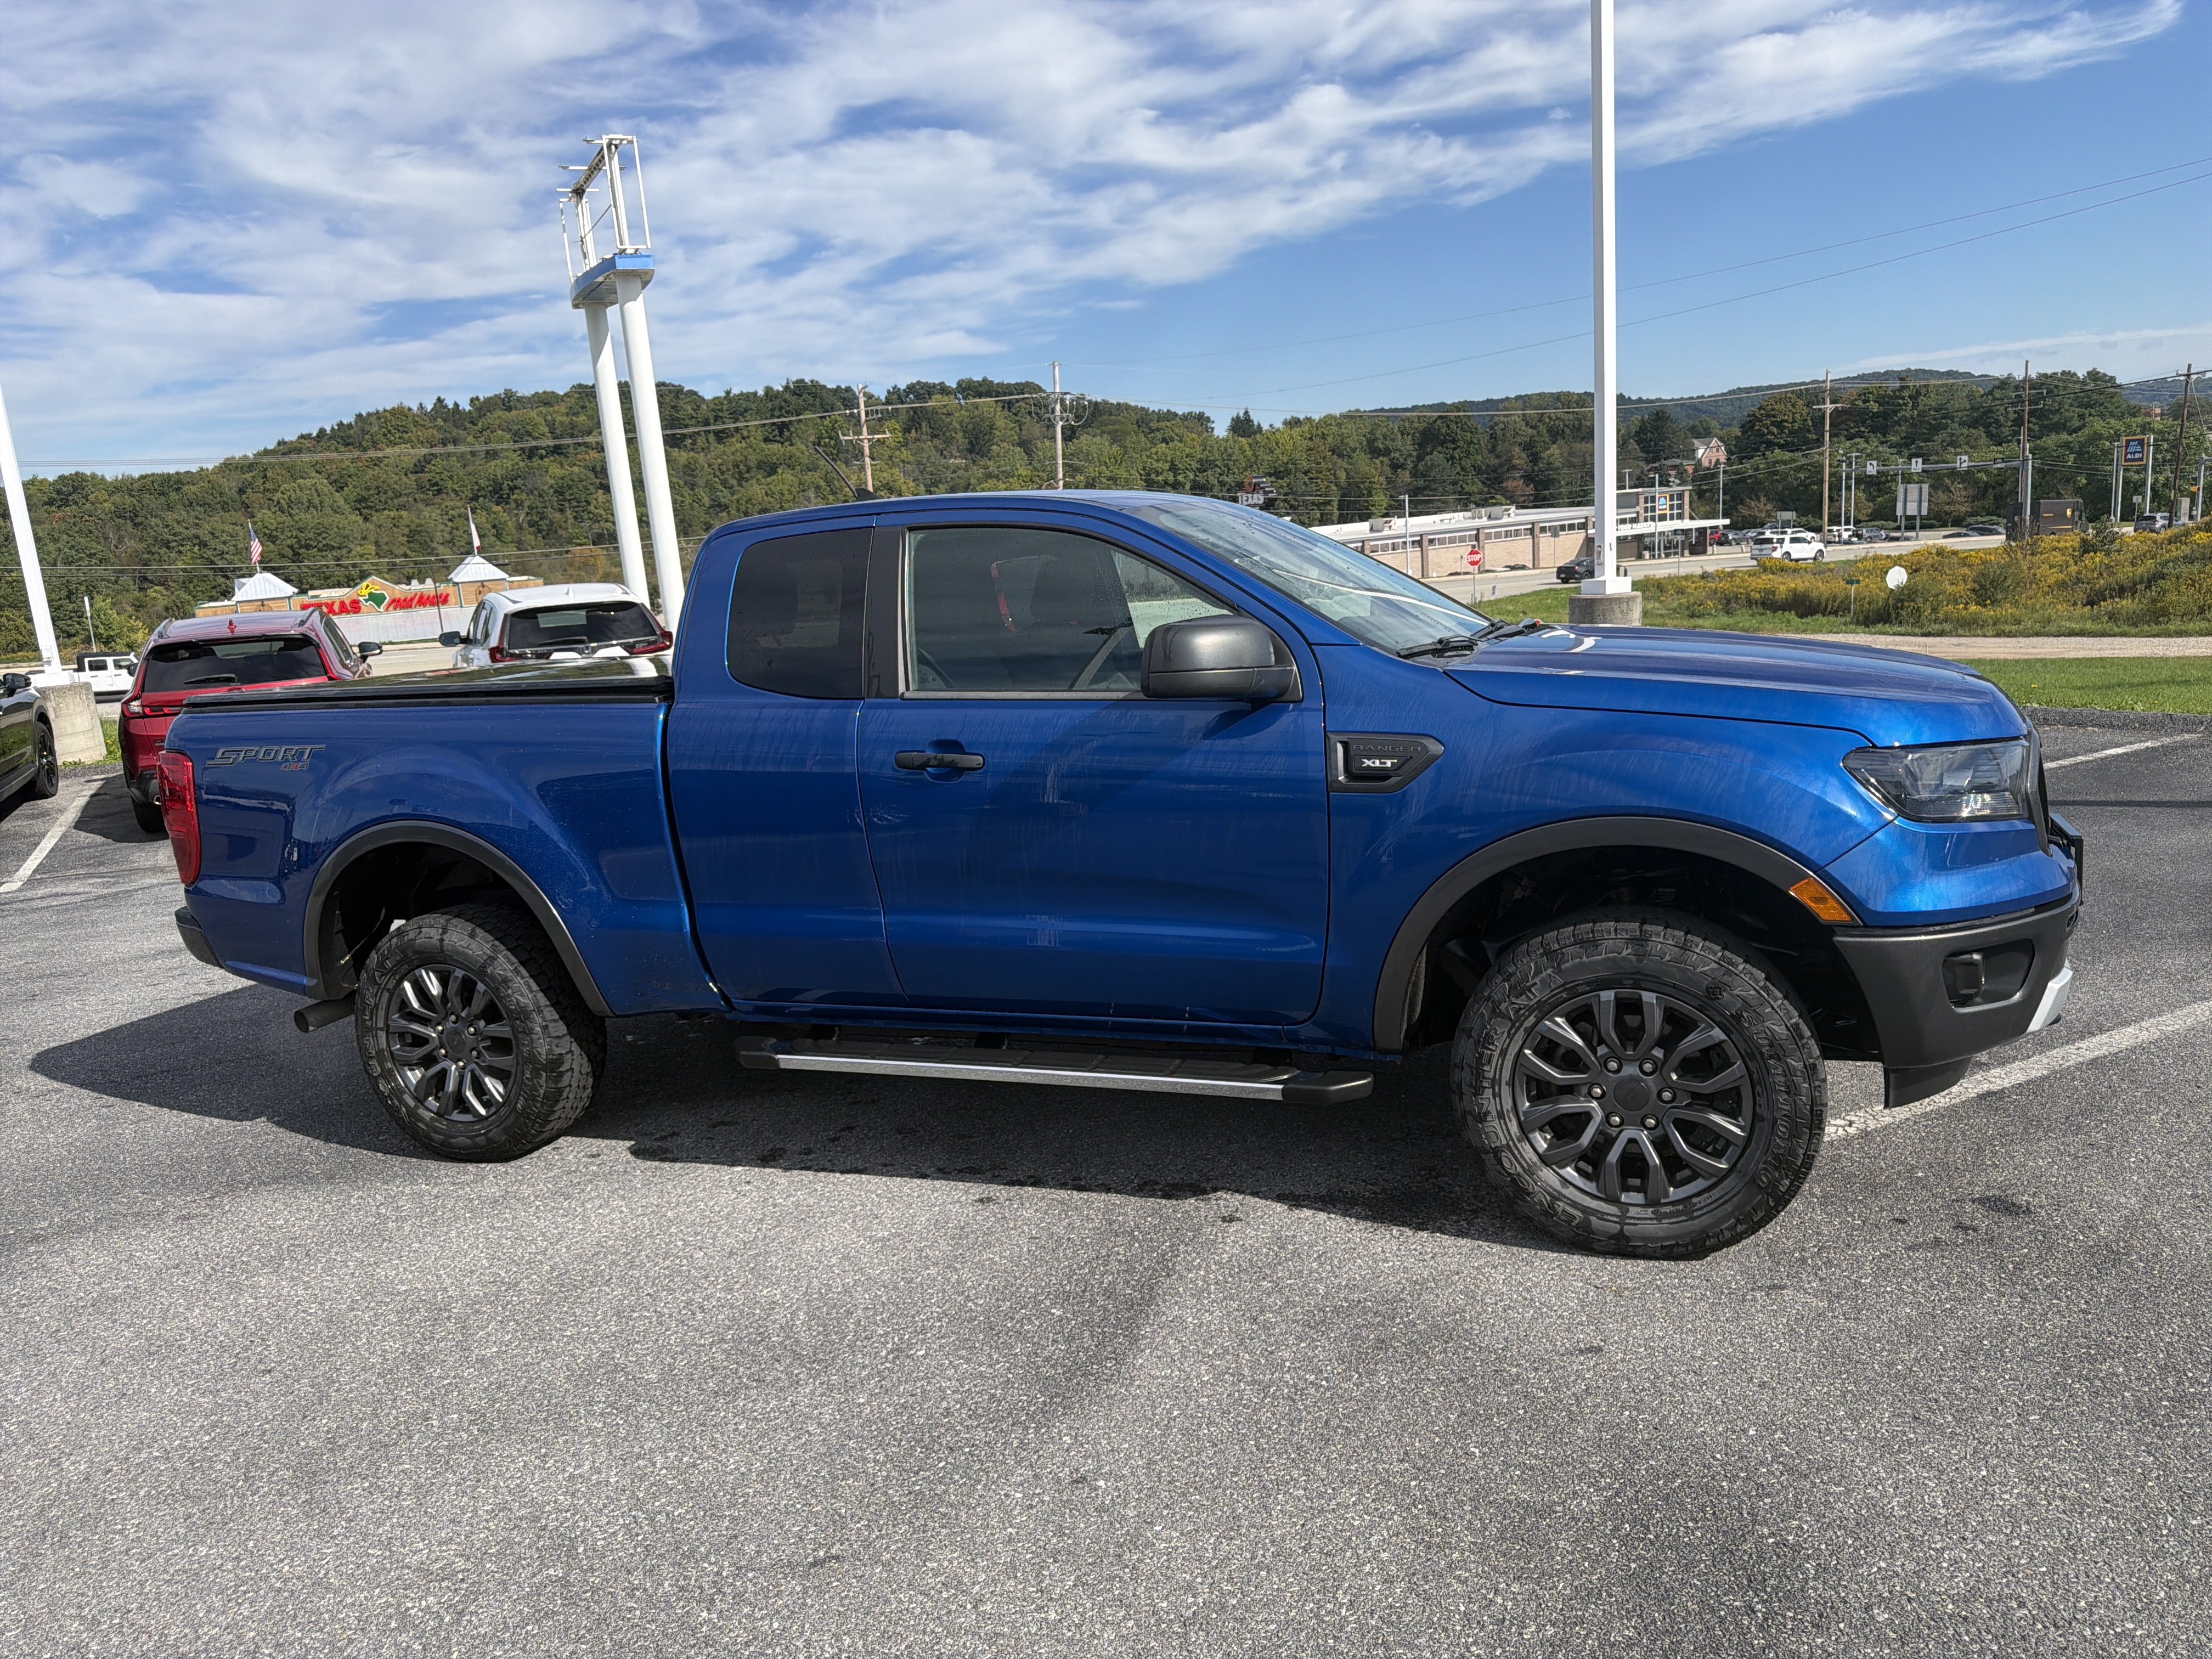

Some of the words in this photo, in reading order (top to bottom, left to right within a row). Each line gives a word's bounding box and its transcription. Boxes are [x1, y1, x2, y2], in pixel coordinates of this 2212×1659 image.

[1237, 491, 1264, 505] TEXAS
[1467, 554, 1481, 562] STOP
[1353, 744, 1421, 752] RANGER
[205, 744, 326, 767] SPORT
[1361, 759, 1397, 768] XLT
[1477, 1025, 1584, 1227] ENCOUNTER
